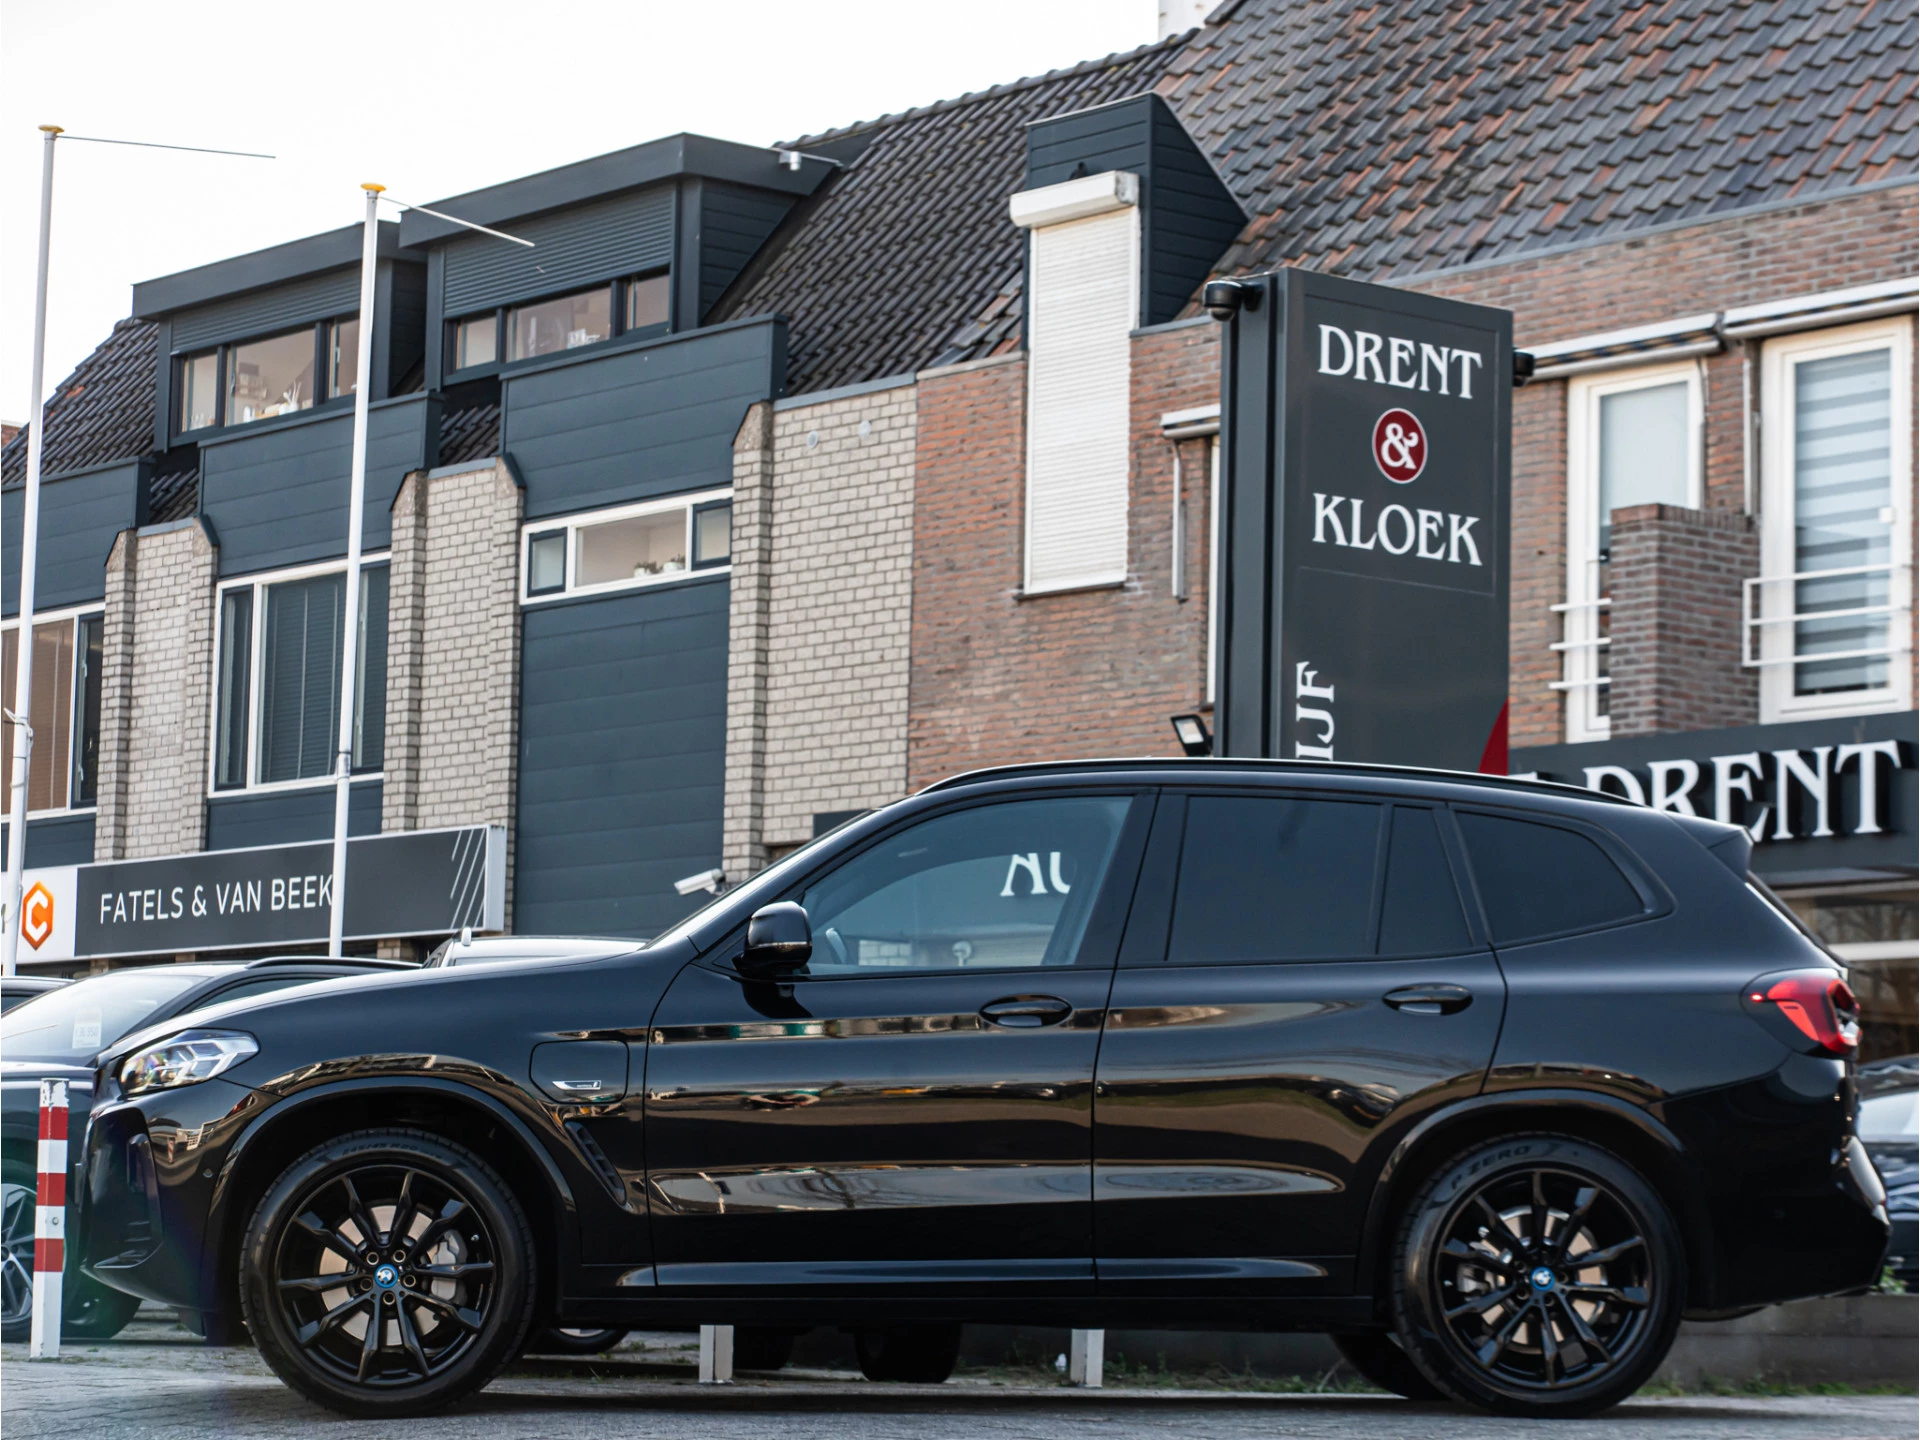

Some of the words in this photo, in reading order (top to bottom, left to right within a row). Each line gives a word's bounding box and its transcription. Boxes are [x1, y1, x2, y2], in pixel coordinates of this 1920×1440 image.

[1318, 324, 1482, 399] DRENT
[1380, 421, 1420, 470] &
[1312, 493, 1483, 566] KLOEK
[100, 887, 184, 924] FATELS
[191, 884, 208, 917] &
[216, 879, 262, 915] VAN
[270, 874, 333, 910] BEEK
